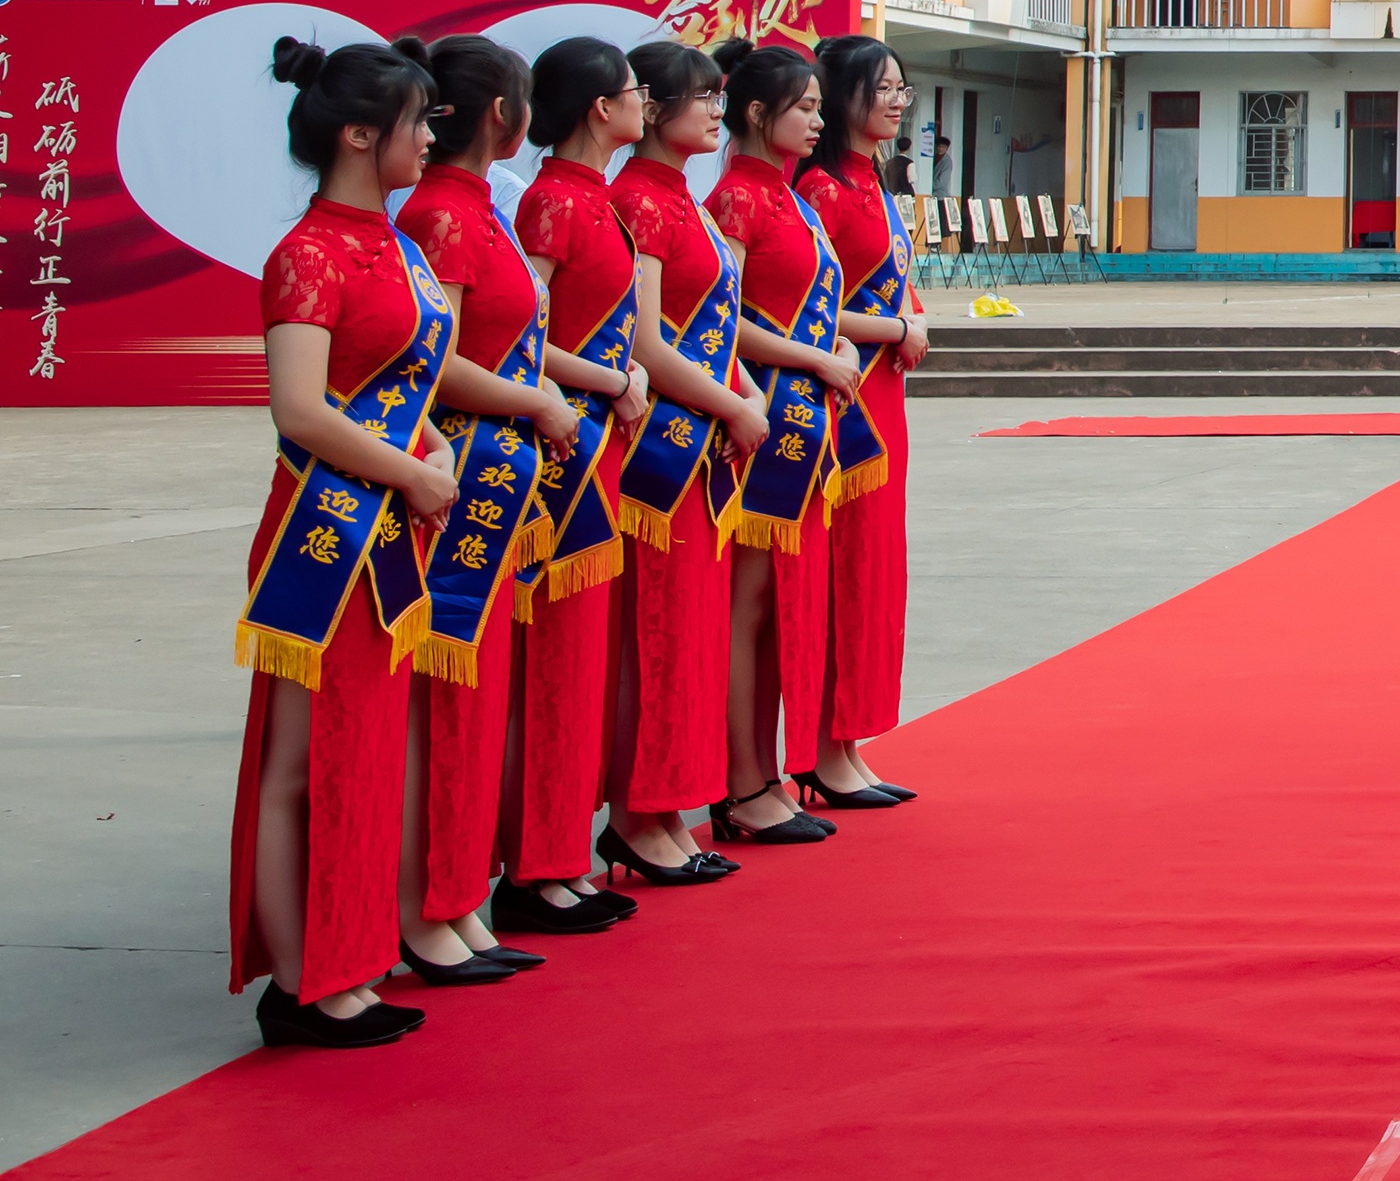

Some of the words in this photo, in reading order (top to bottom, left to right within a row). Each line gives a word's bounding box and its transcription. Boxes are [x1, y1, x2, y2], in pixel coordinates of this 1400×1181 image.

[29, 76, 80, 380] 砥砺前行正青春
